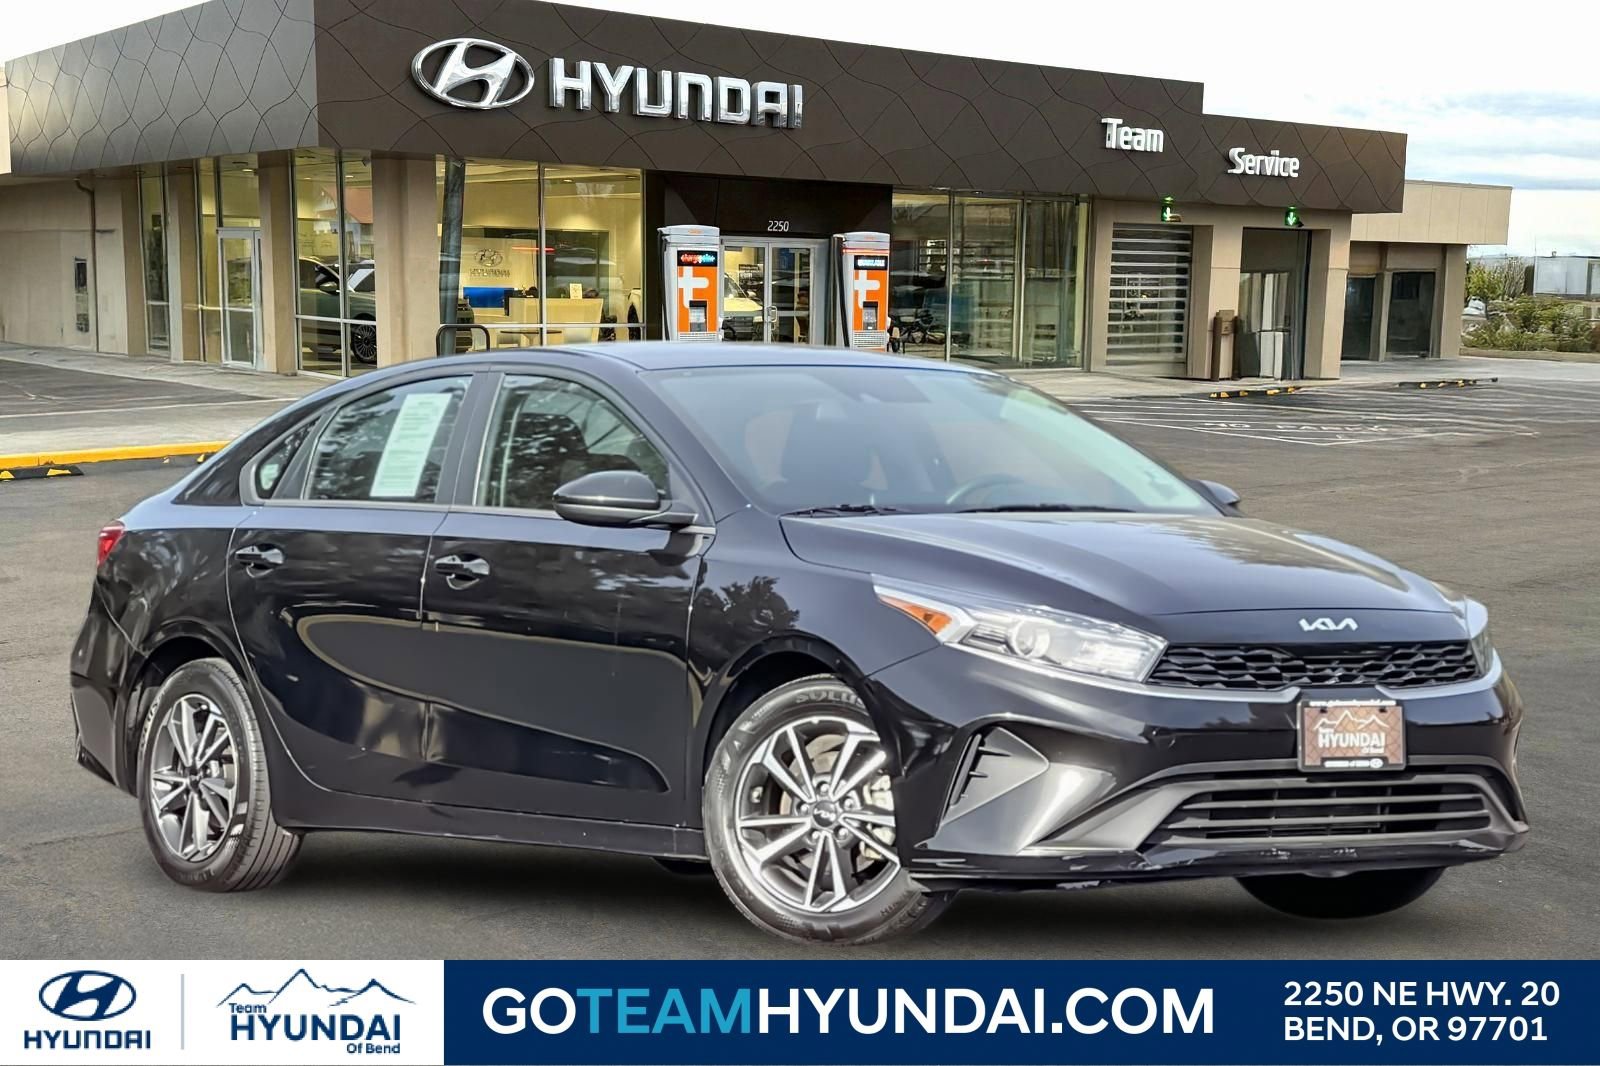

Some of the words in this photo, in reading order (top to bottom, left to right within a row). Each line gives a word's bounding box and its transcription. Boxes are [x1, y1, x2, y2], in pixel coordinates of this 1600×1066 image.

[548, 57, 803, 129] HYUNDAI
[1101, 117, 1164, 153] Team
[1227, 147, 1300, 178] Service
[767, 220, 790, 233] 2250
[1299, 618, 1359, 631] KIA
[1318, 731, 1386, 749] HYUNDAI
